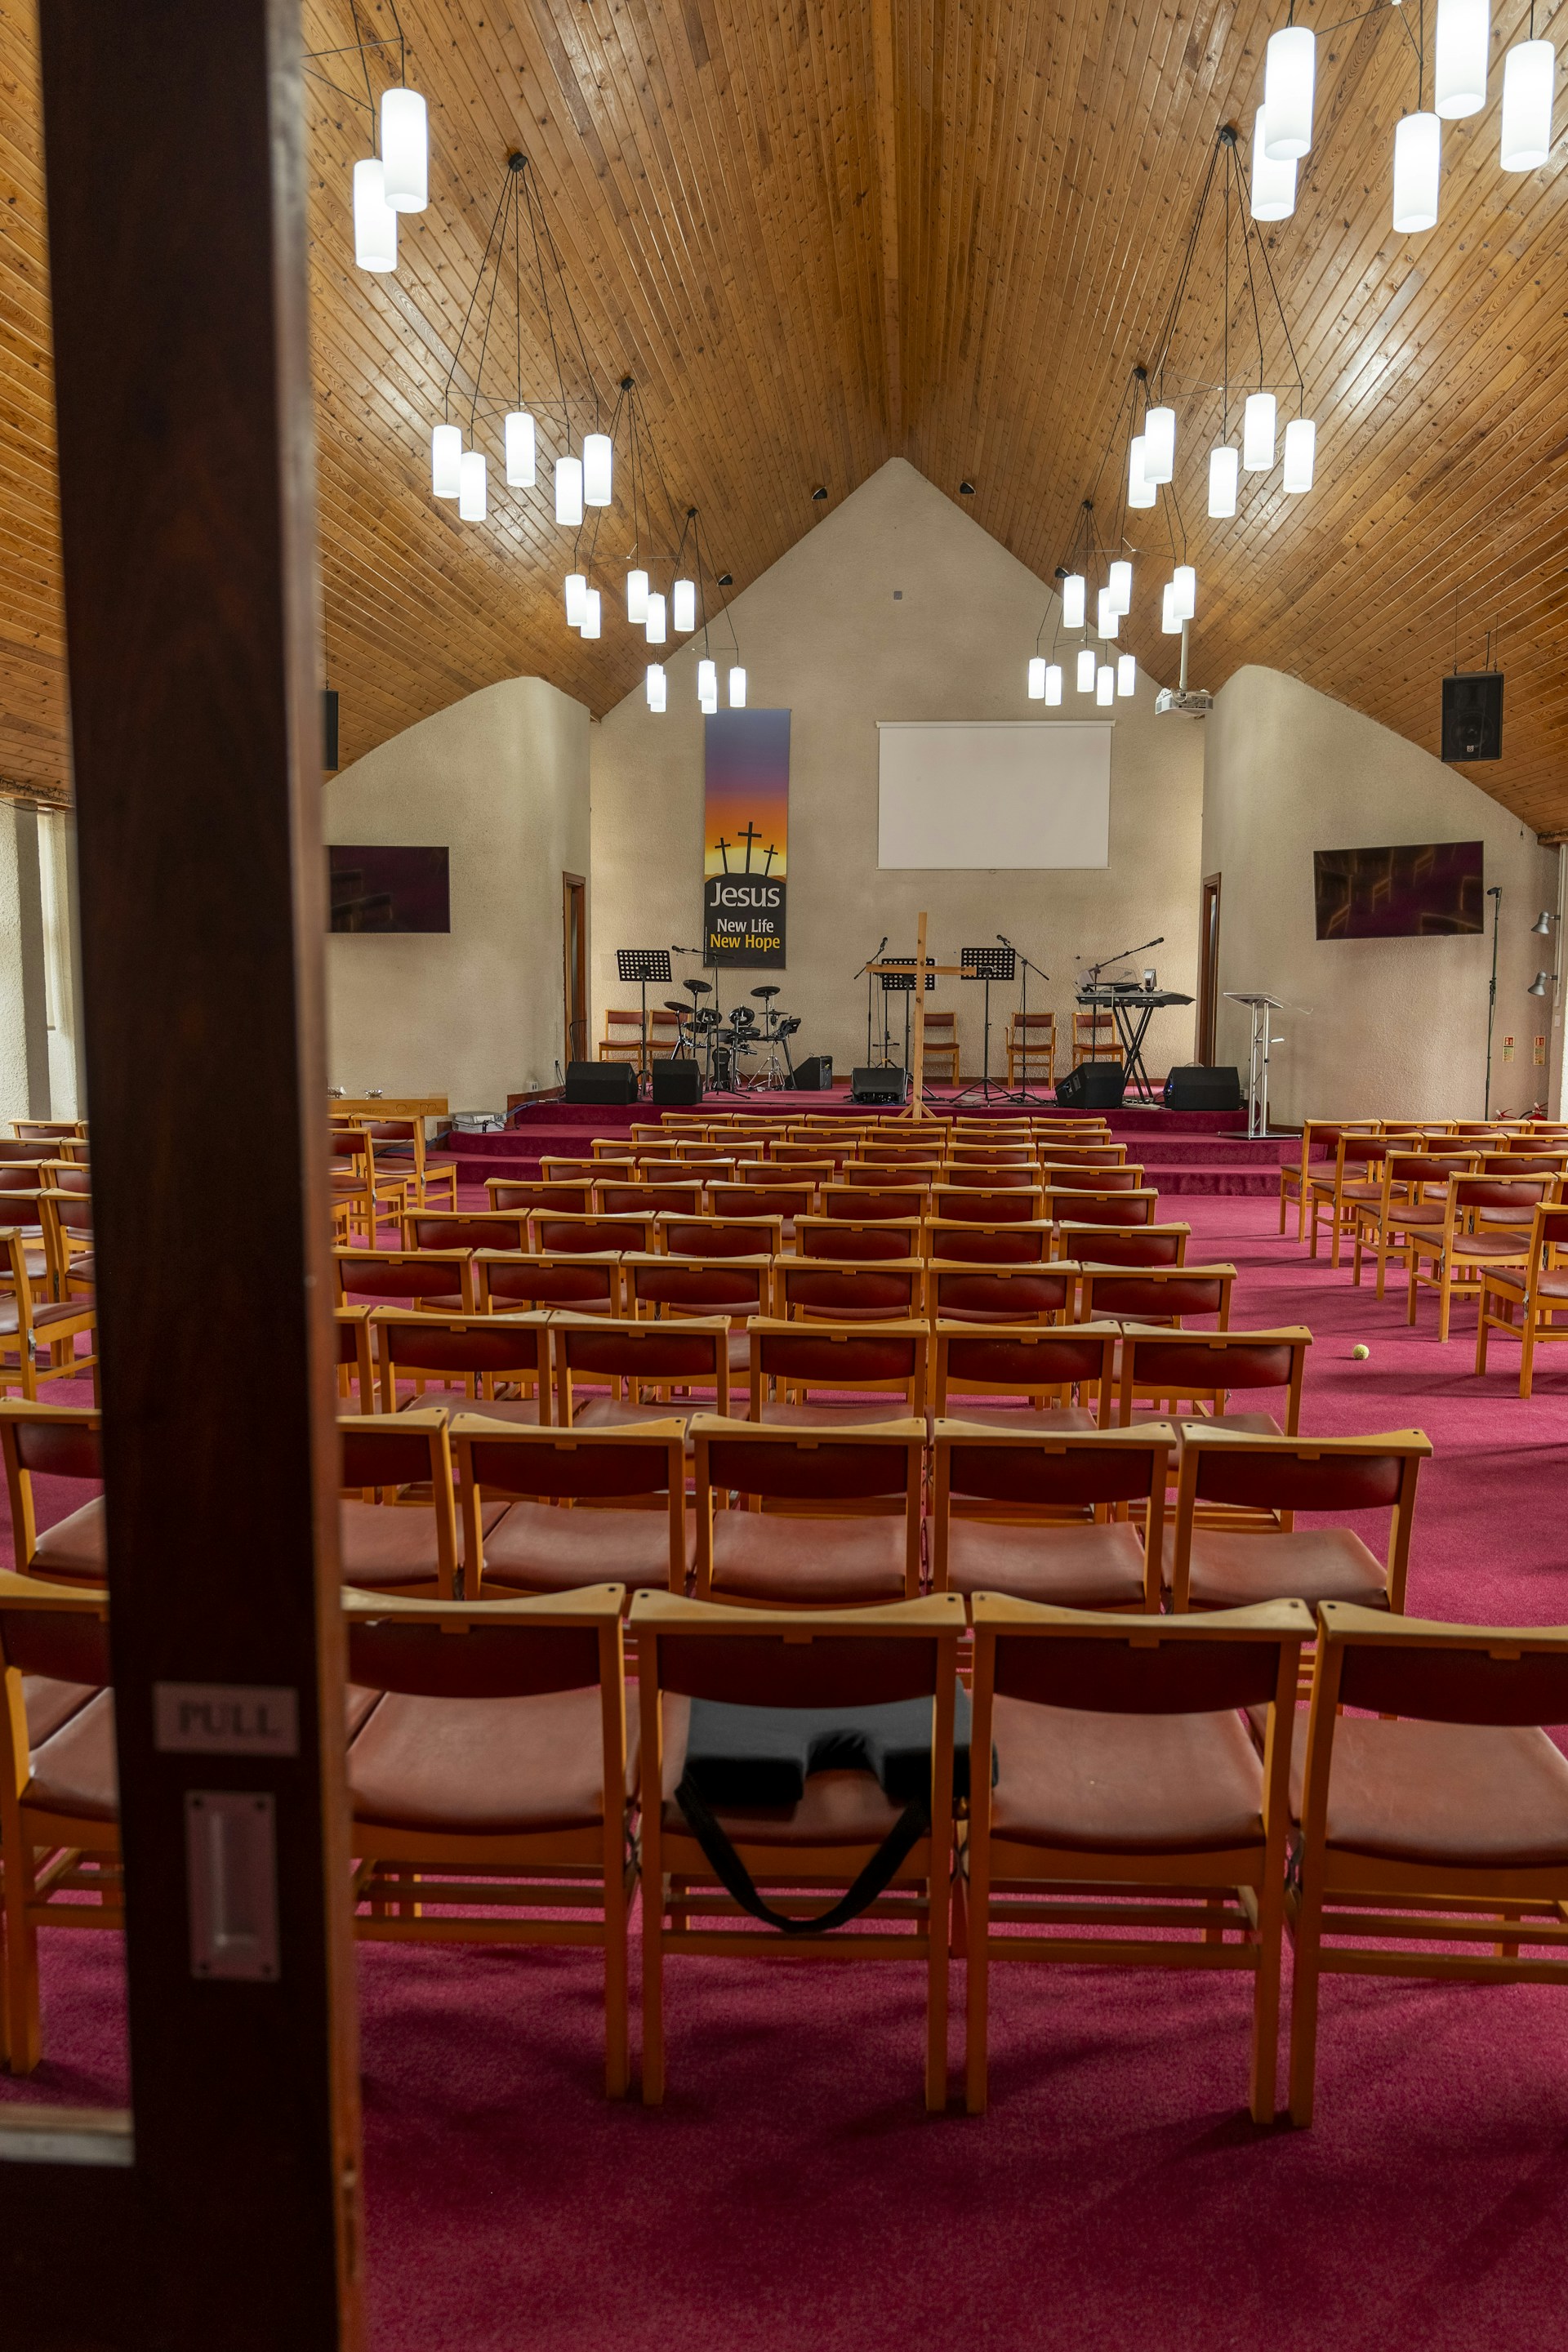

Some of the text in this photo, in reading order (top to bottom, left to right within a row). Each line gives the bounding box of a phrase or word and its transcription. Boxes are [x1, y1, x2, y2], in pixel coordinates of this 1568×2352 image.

[710, 882, 781, 908] Jesus
[717, 918, 775, 933] New Life
[710, 933, 742, 948] New
[745, 933, 781, 952] Hope
[178, 1699, 282, 1738] PULL
